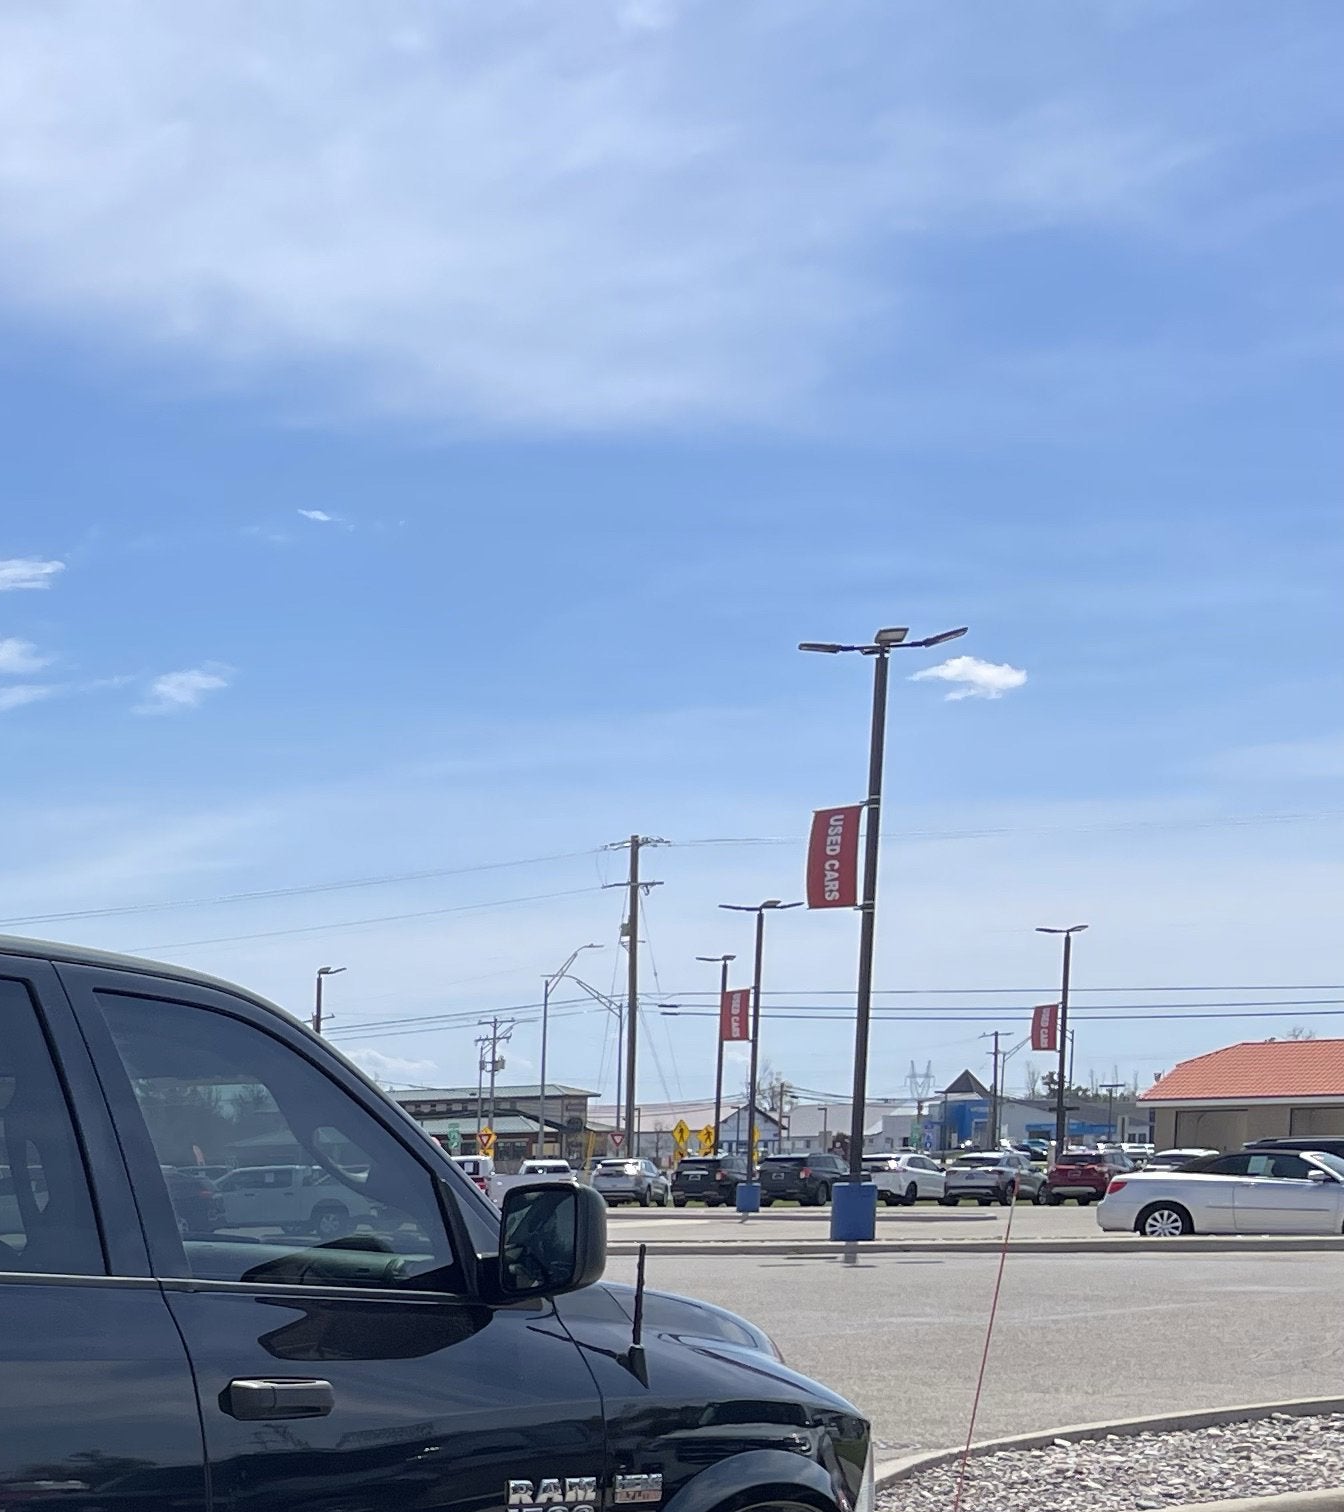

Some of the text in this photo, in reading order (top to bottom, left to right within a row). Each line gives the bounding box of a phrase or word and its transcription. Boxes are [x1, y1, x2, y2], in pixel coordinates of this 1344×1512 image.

[824, 814, 845, 901] USED CARS
[506, 1476, 597, 1505] RAM
